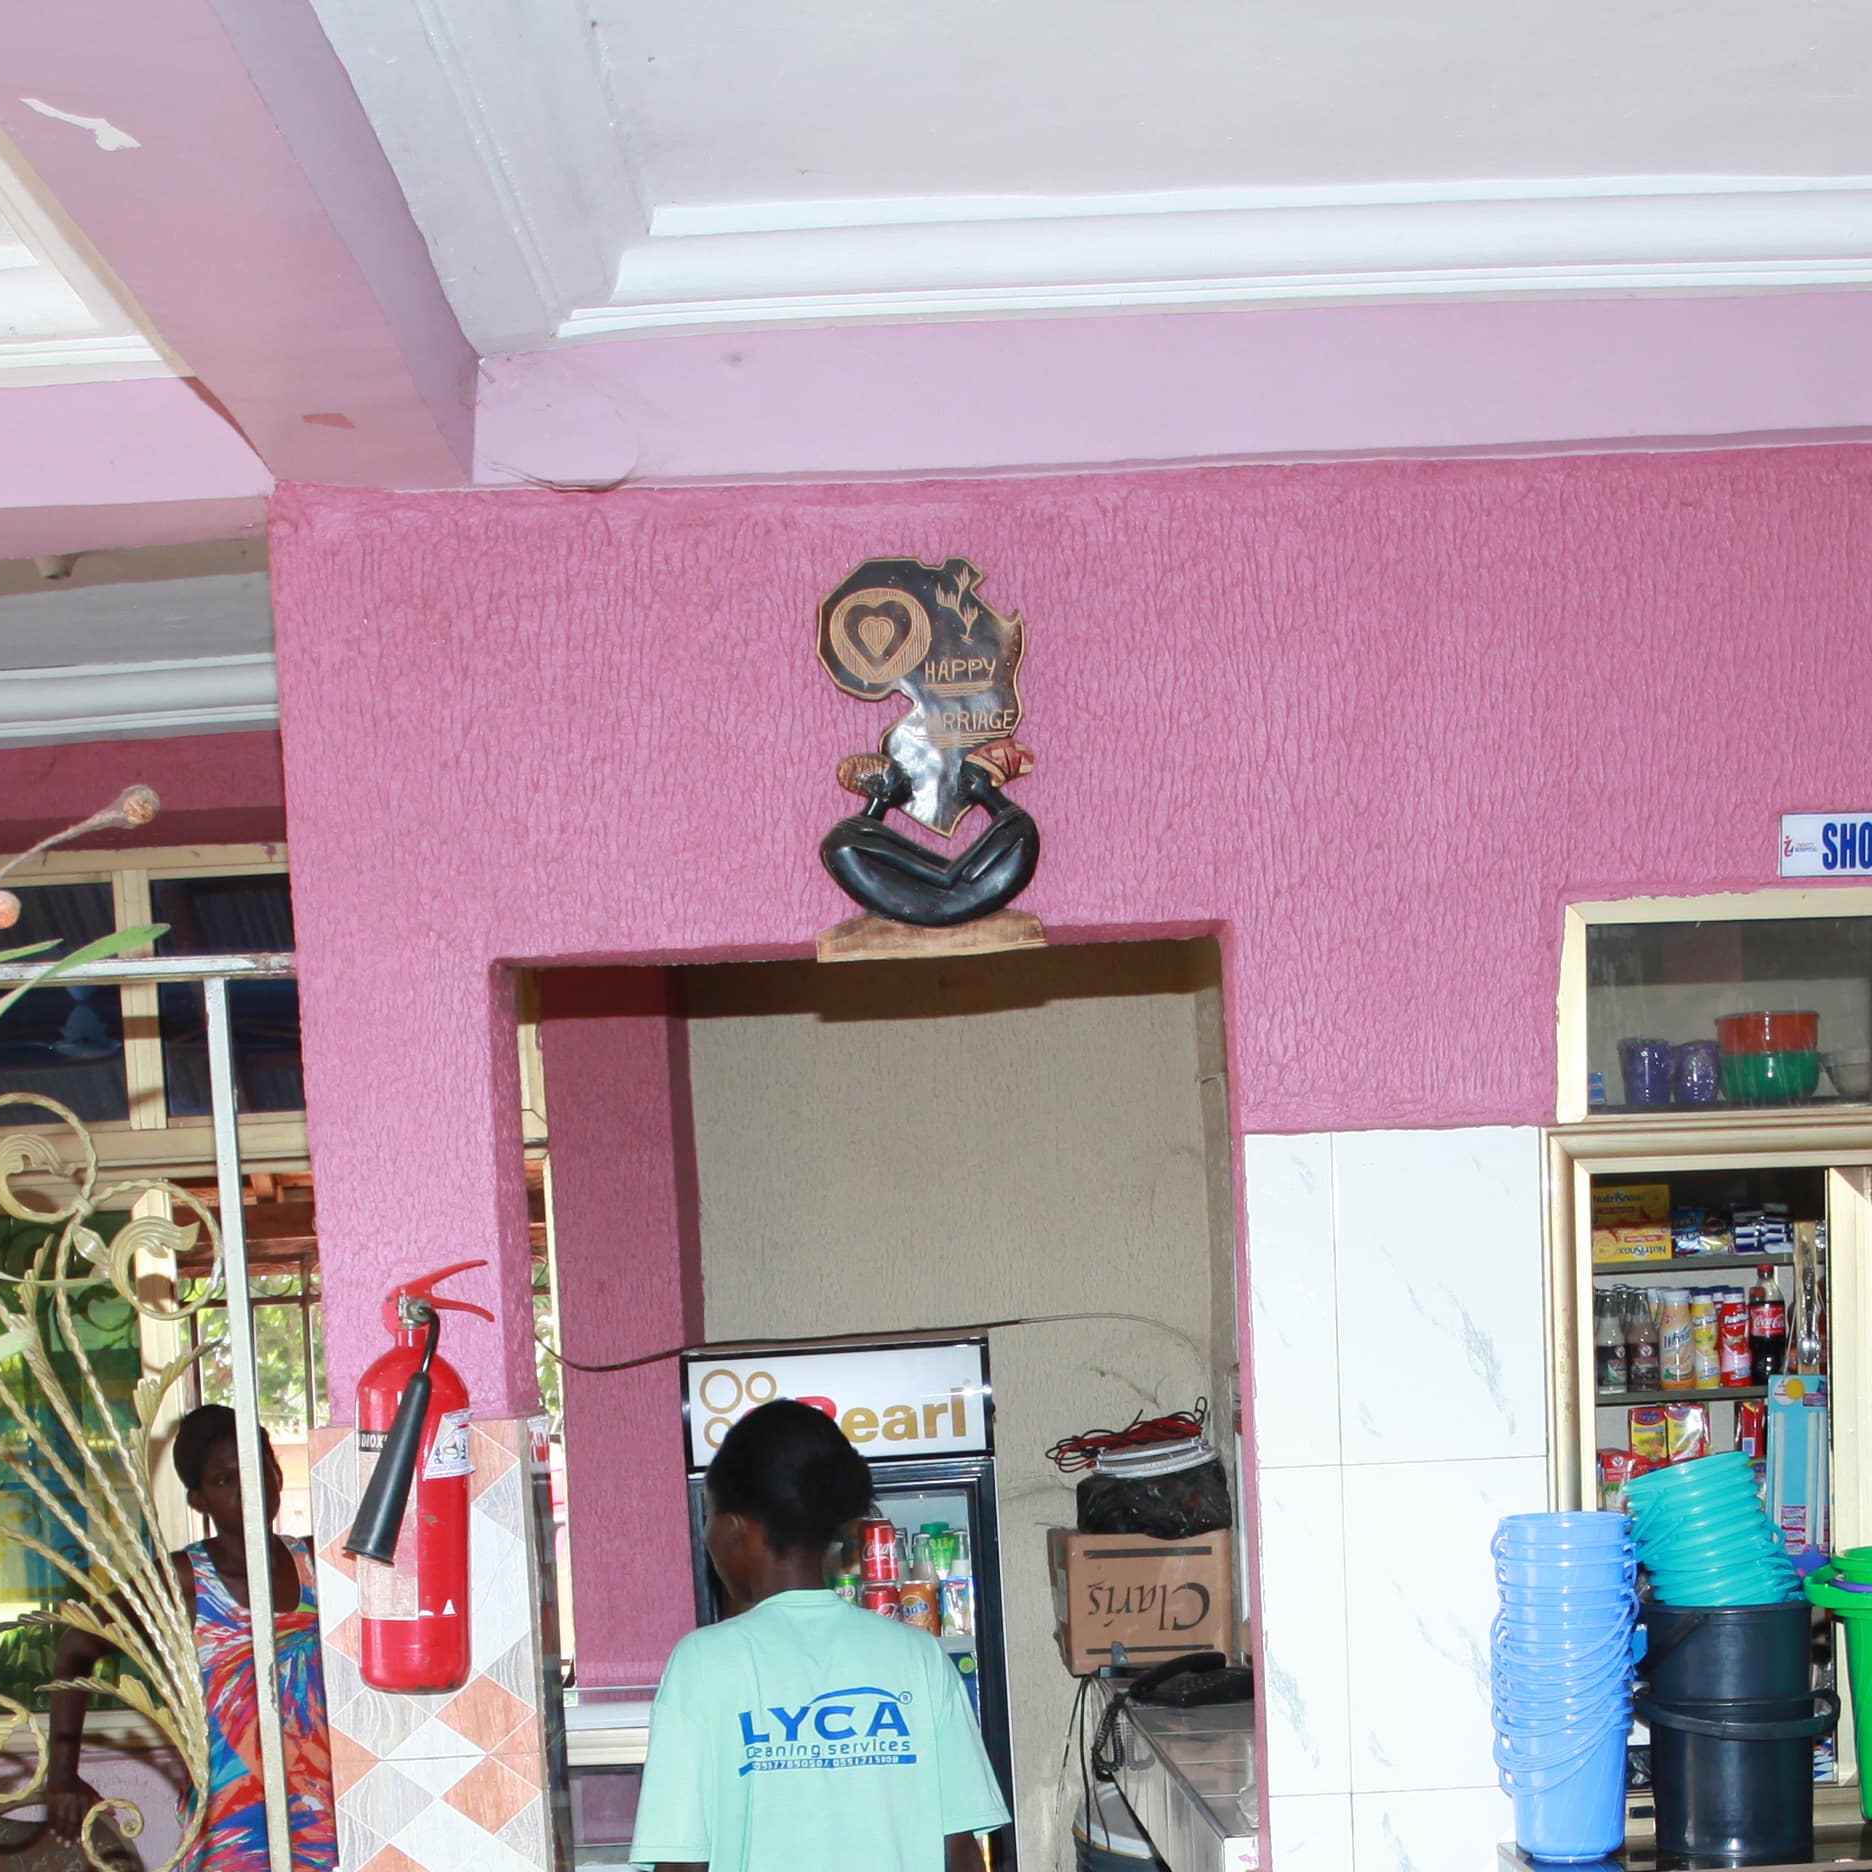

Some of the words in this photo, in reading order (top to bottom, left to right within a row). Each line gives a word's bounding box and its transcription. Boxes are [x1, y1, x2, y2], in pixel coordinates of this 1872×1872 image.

[925, 657, 996, 683] HAPPY
[1087, 1580, 1211, 1632] Claris
[738, 1701, 911, 1746] LYCA
[828, 1738, 911, 1756] services
